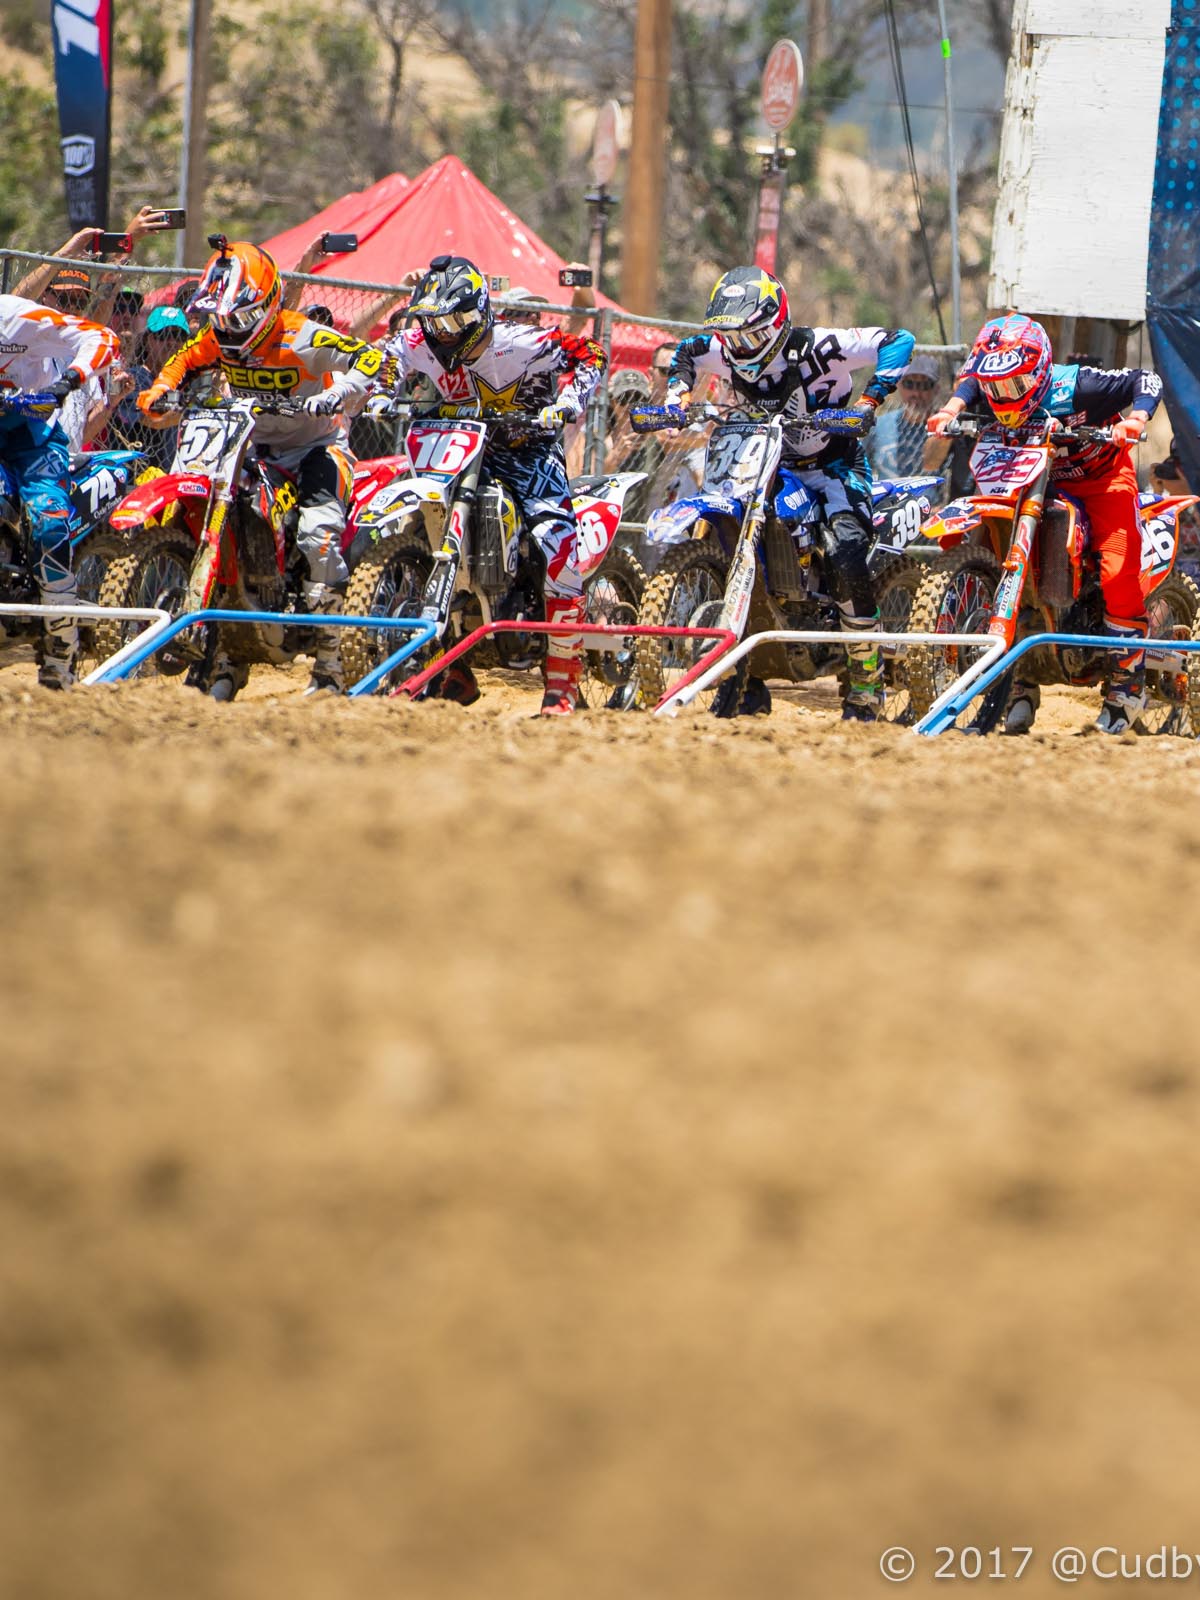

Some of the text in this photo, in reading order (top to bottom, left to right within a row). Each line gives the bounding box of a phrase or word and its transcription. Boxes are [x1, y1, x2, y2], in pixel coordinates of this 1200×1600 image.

[415, 432, 471, 471] 16
[705, 433, 768, 482] 39
[80, 467, 117, 514] 74
[891, 500, 921, 548] 39
[441, 562, 456, 615] DUNLOP
